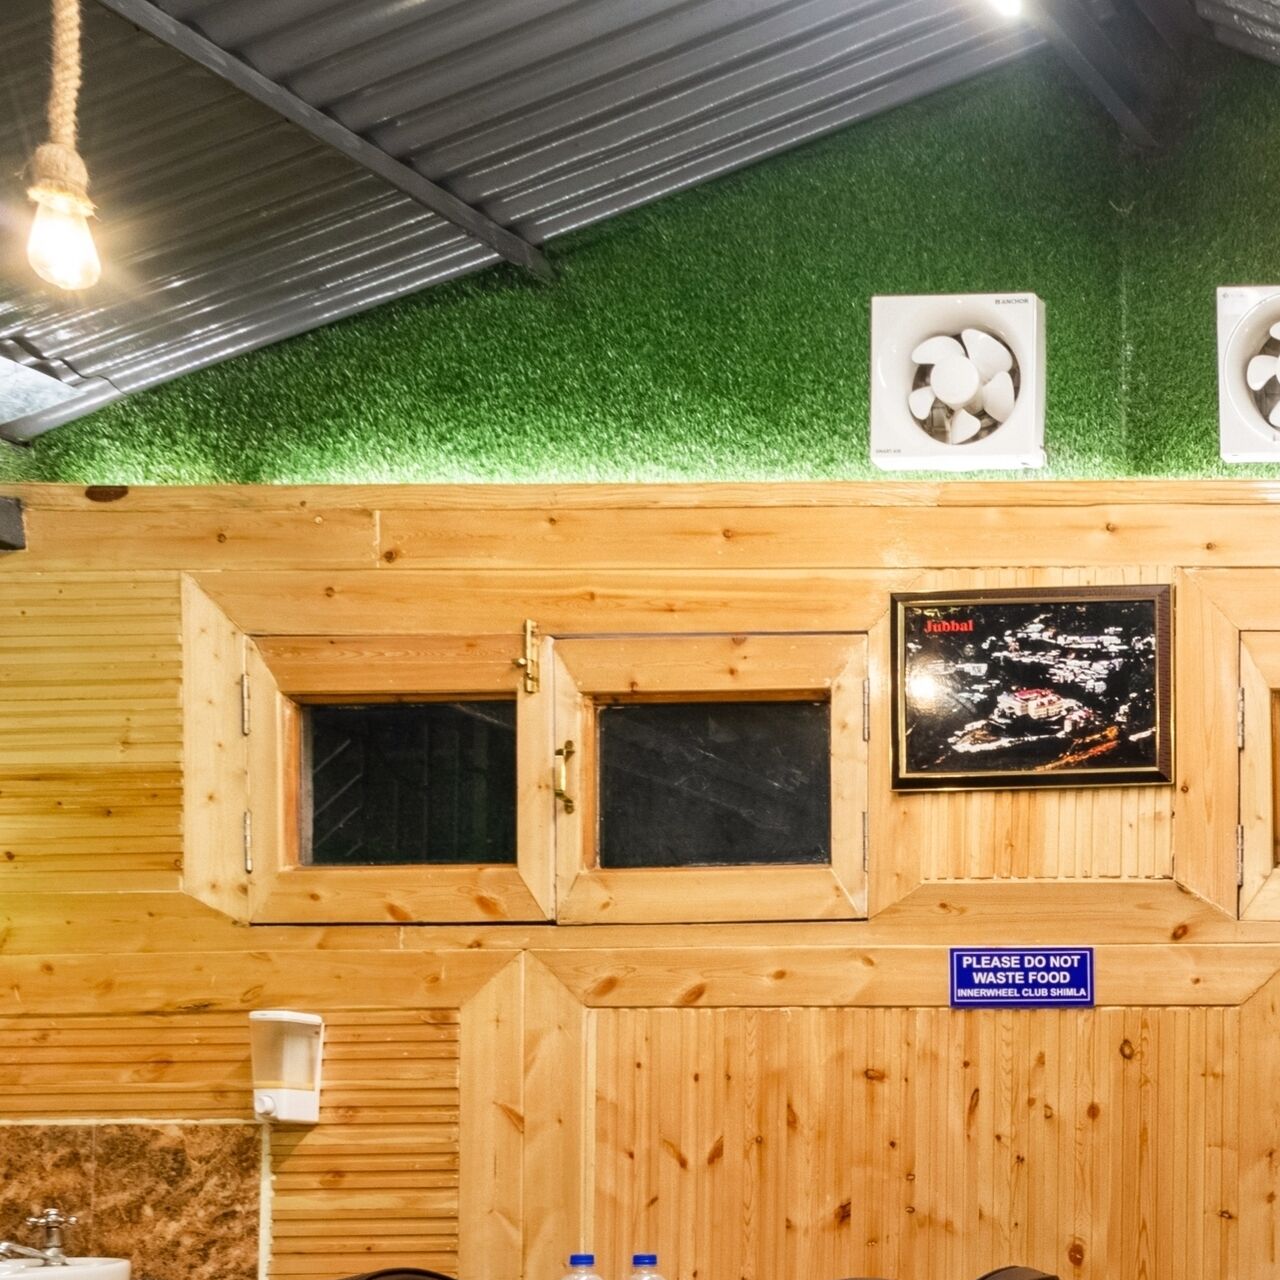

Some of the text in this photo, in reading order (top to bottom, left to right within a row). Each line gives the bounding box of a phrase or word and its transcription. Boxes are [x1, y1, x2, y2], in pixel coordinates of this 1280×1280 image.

[924, 619, 973, 633] Jubbal
[962, 955, 1081, 968] PLEASE DO NOT
[972, 972, 1070, 984] WASTE FOOD
[957, 987, 1086, 997] INNERWHEEL CLUB SHIMLA
